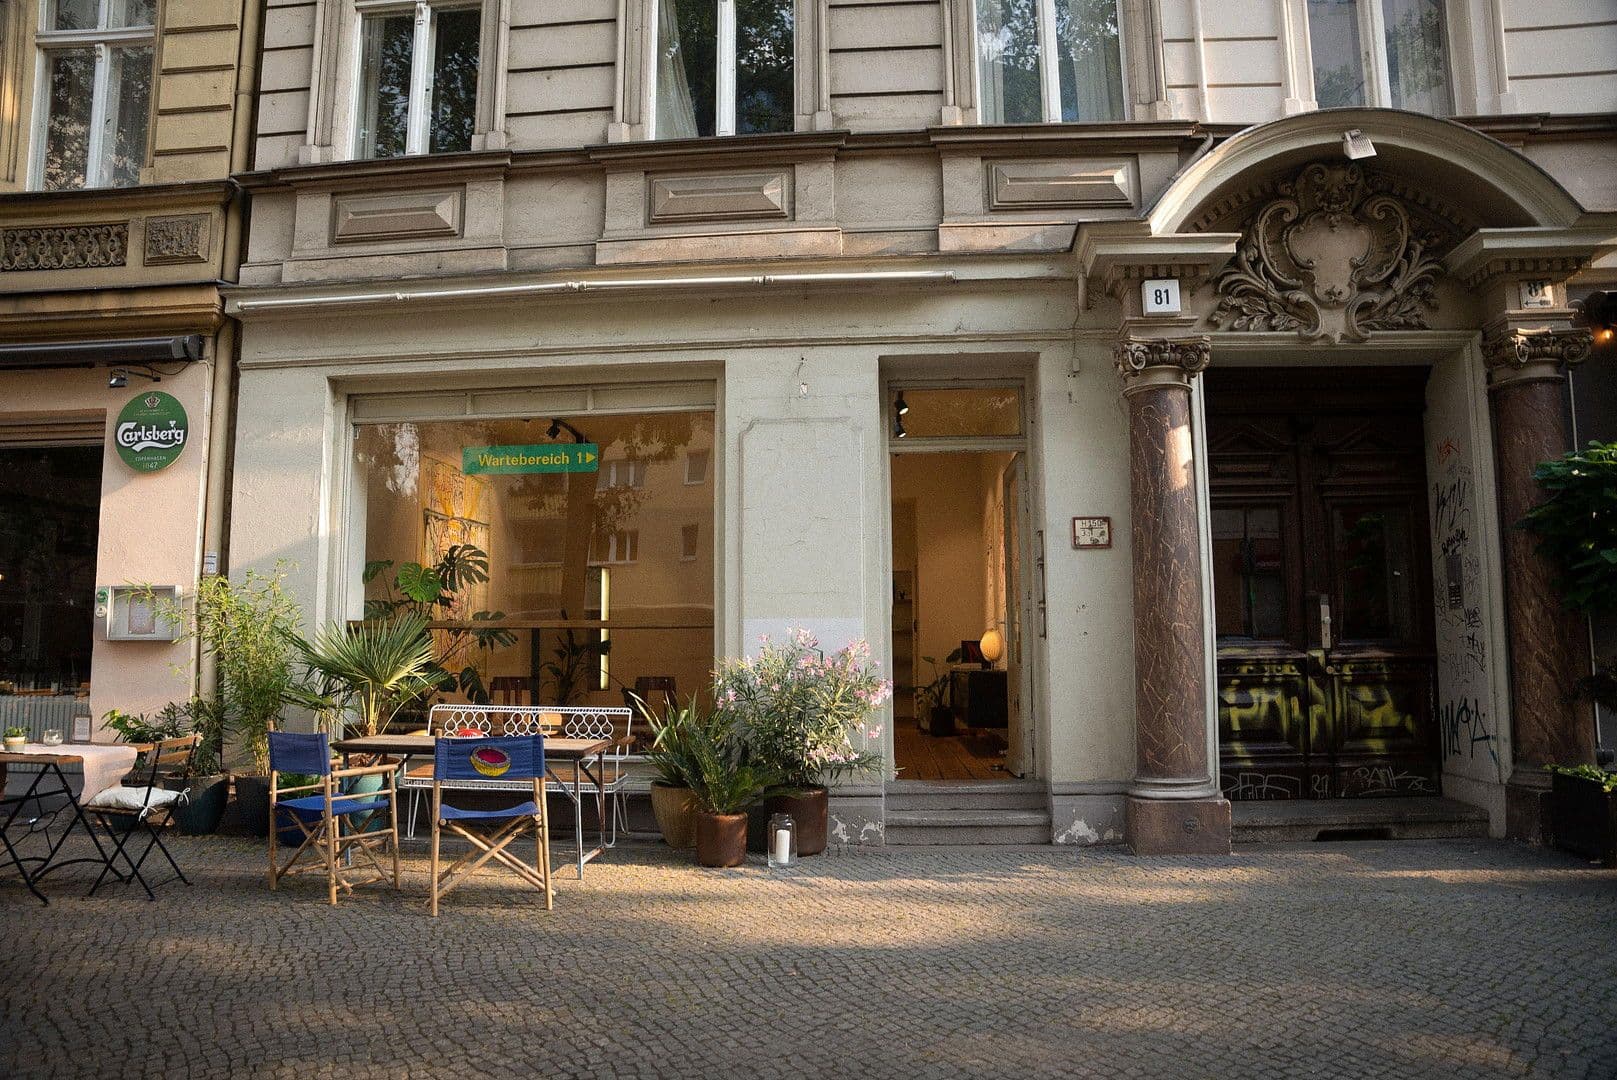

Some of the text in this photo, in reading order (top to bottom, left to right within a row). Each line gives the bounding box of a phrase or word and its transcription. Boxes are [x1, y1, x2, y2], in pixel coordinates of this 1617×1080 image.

[1154, 288, 1170, 306] 81
[116, 420, 185, 452] Carlsberg
[478, 451, 583, 467] Wartebereich 1
